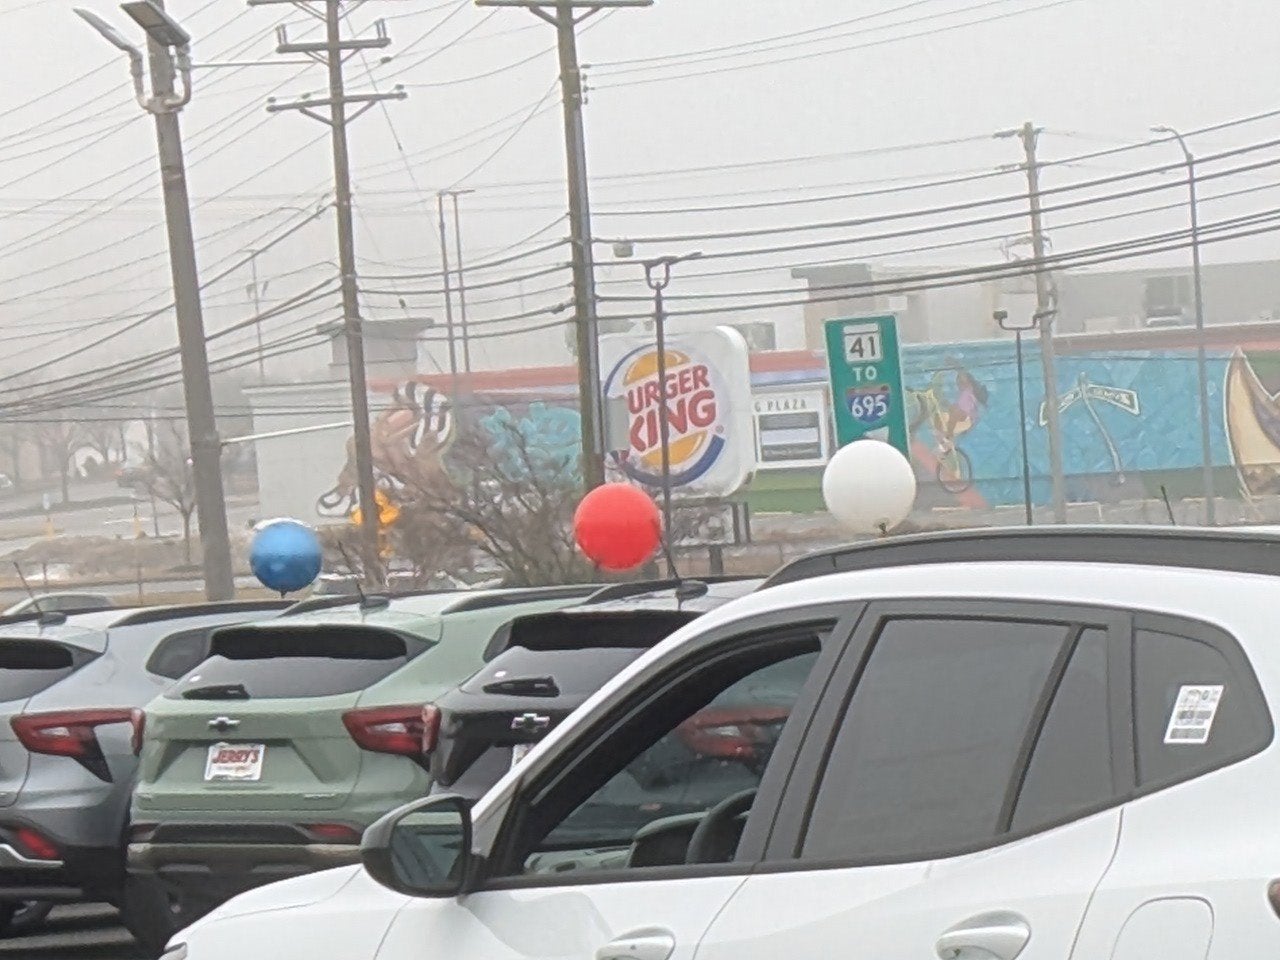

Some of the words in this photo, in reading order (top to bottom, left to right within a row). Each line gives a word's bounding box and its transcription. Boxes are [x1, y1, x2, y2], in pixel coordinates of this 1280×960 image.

[850, 336, 876, 359] 41
[852, 365, 878, 381] TO
[627, 364, 710, 415] URGER
[767, 398, 807, 411] PLAZA
[851, 394, 888, 418] 695
